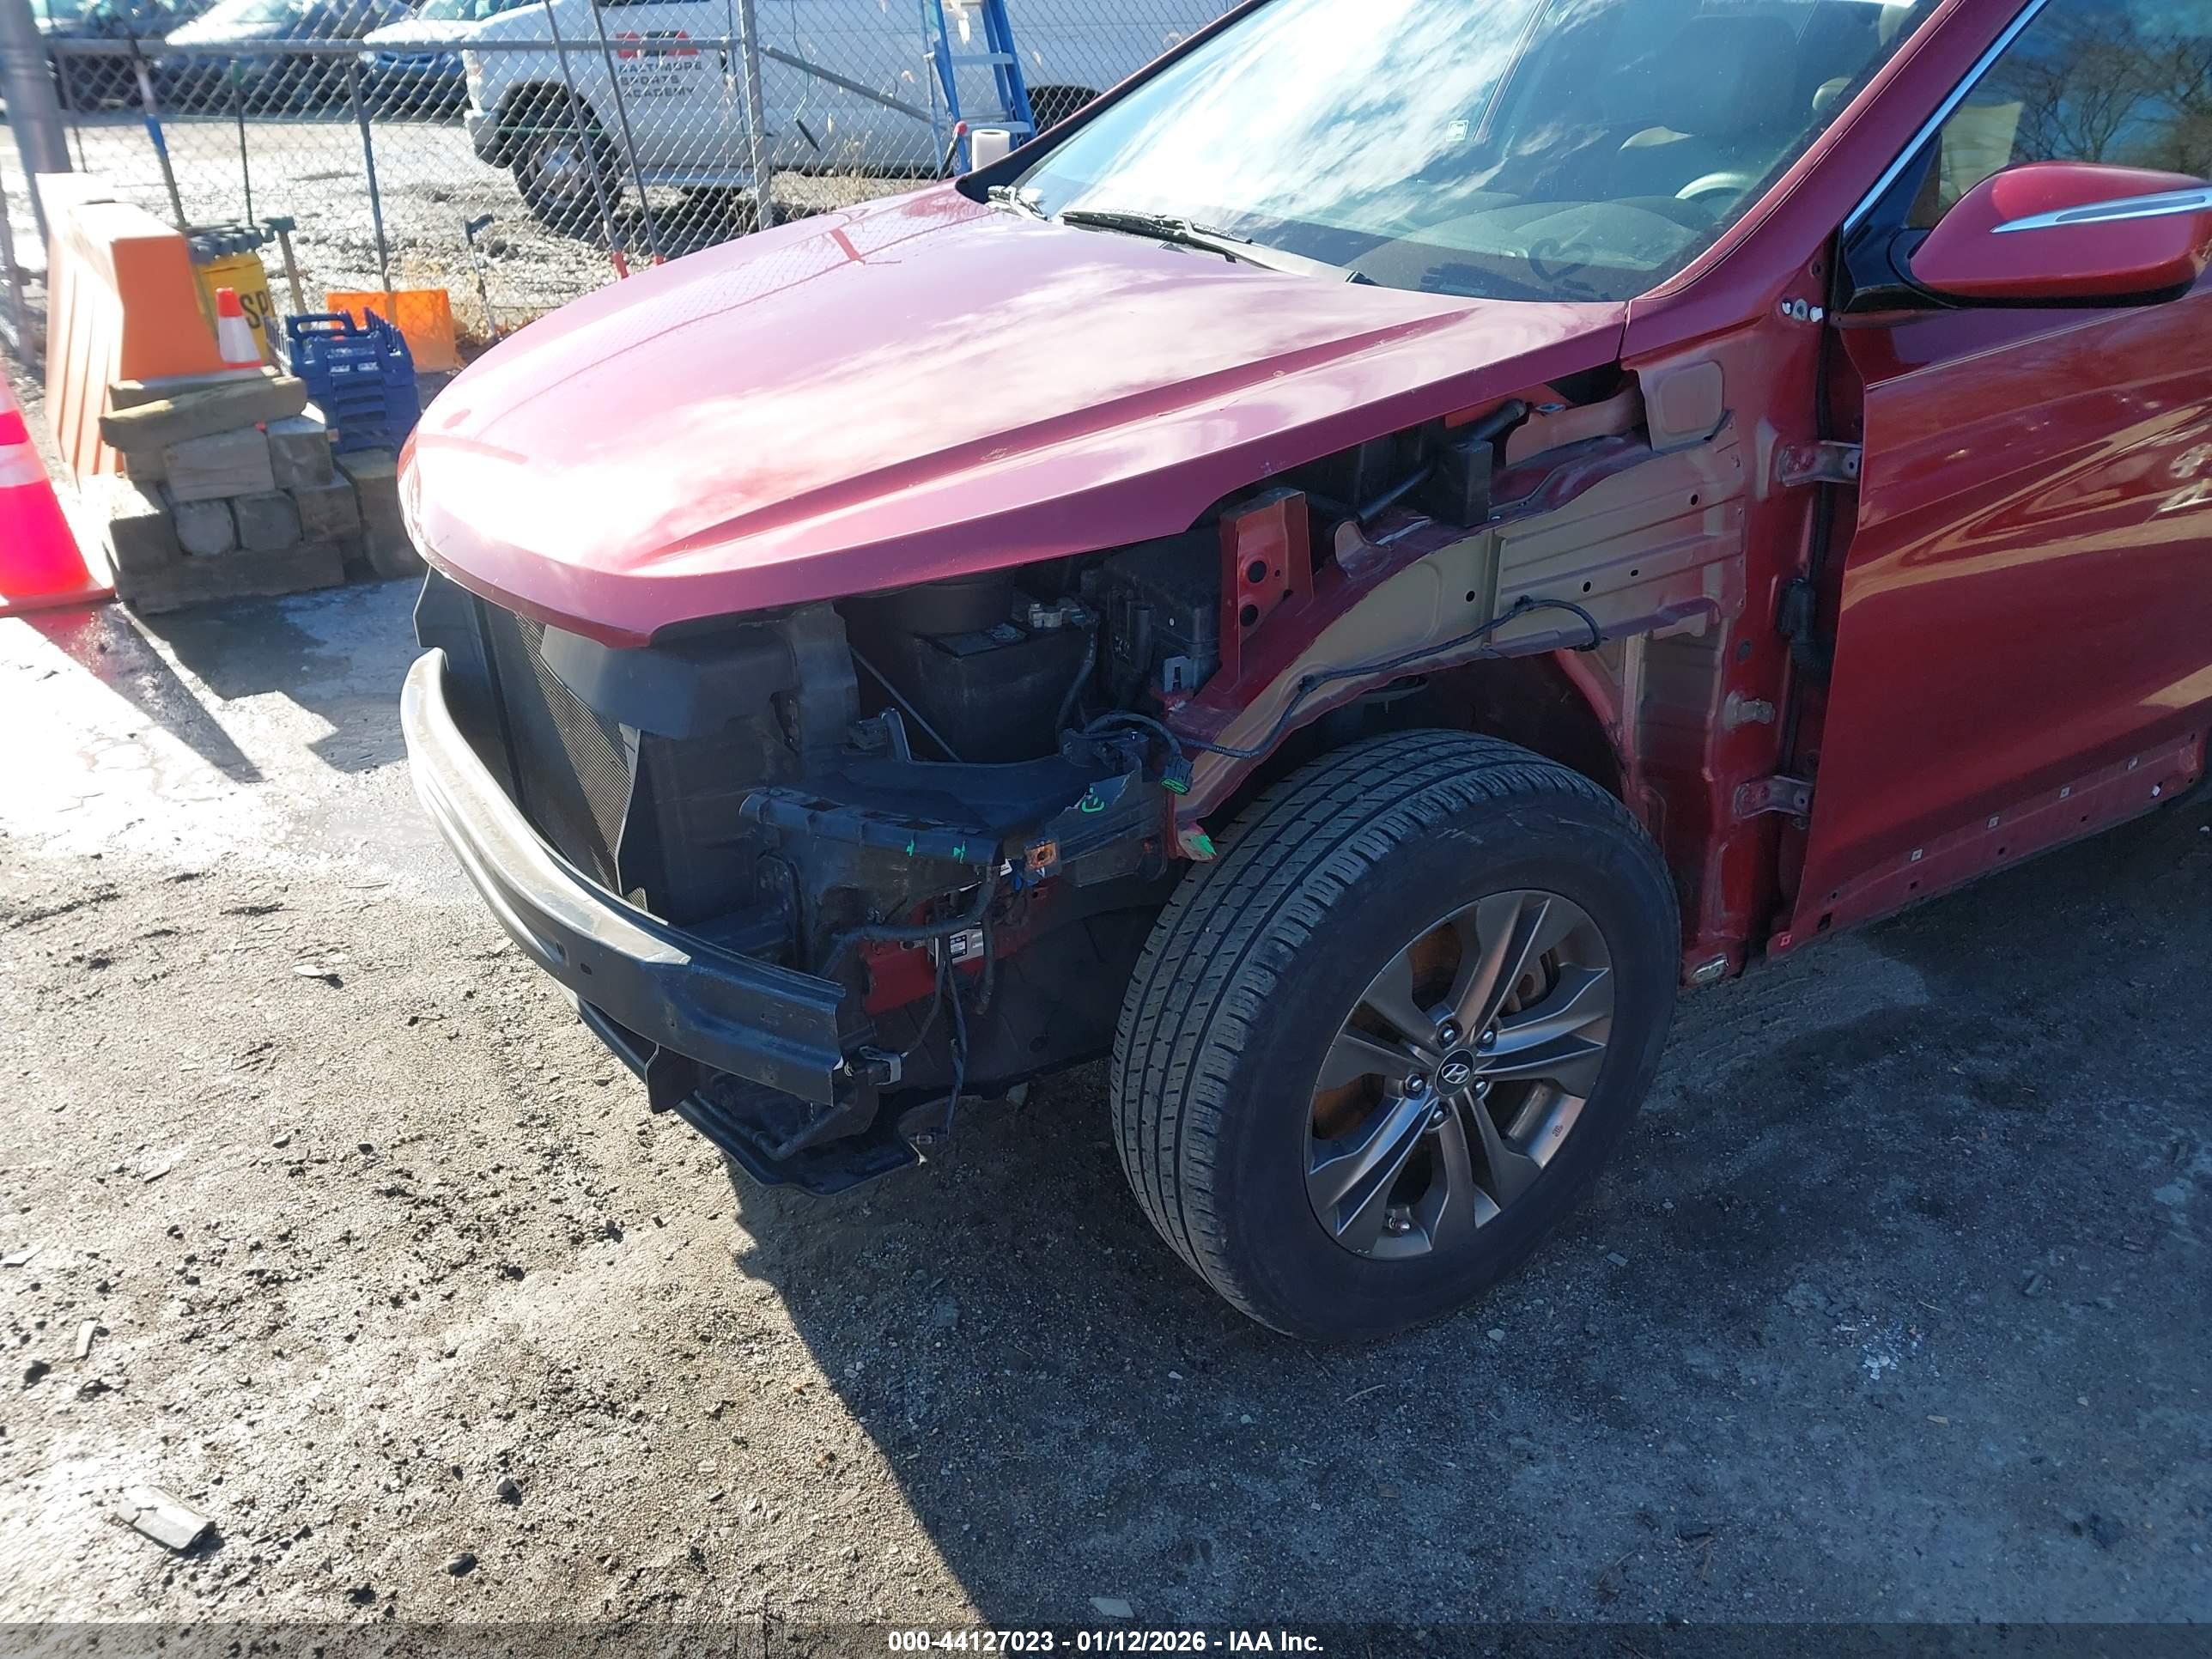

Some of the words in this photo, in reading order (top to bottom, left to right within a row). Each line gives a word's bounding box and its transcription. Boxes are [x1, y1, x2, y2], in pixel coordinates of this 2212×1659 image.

[618, 61, 702, 73] BALTIMORE
[620, 75, 680, 86] SPORTS
[624, 87, 696, 98] ACADEMY
